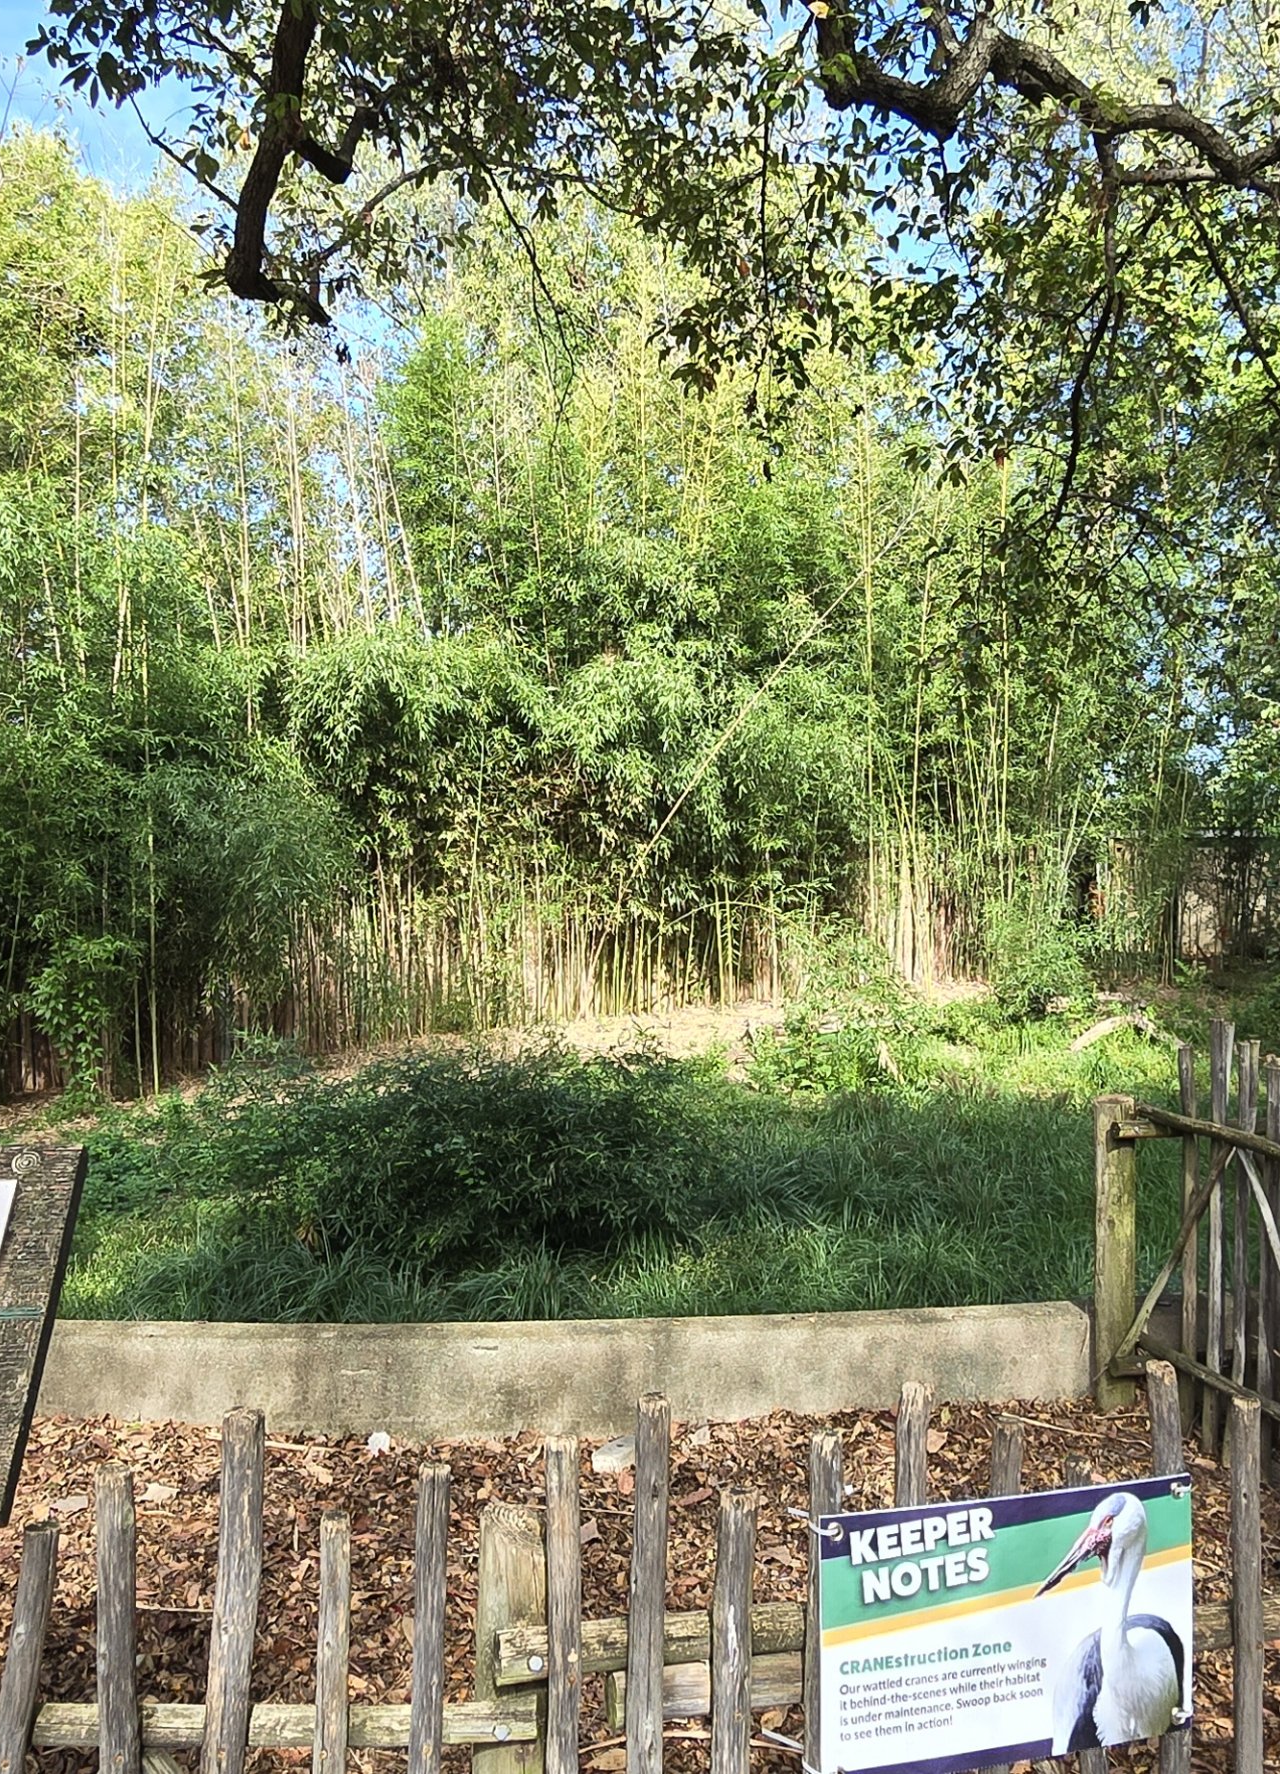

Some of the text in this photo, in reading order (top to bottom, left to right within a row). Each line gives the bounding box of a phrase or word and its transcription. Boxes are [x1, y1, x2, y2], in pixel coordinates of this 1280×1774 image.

[849, 1507, 995, 1566] KEEPER
[862, 1547, 990, 1604] NOTES
[839, 1641, 1012, 1675] CRANEstruction Zone
[839, 1657, 1047, 1695] Our wattled cranes are currently winging
[840, 1672, 1041, 1711] it behind-the-scenes while their habitat
[840, 1687, 1044, 1726] is under maintenance. Swoop back soon
[840, 1714, 953, 1742] to see them in action!
